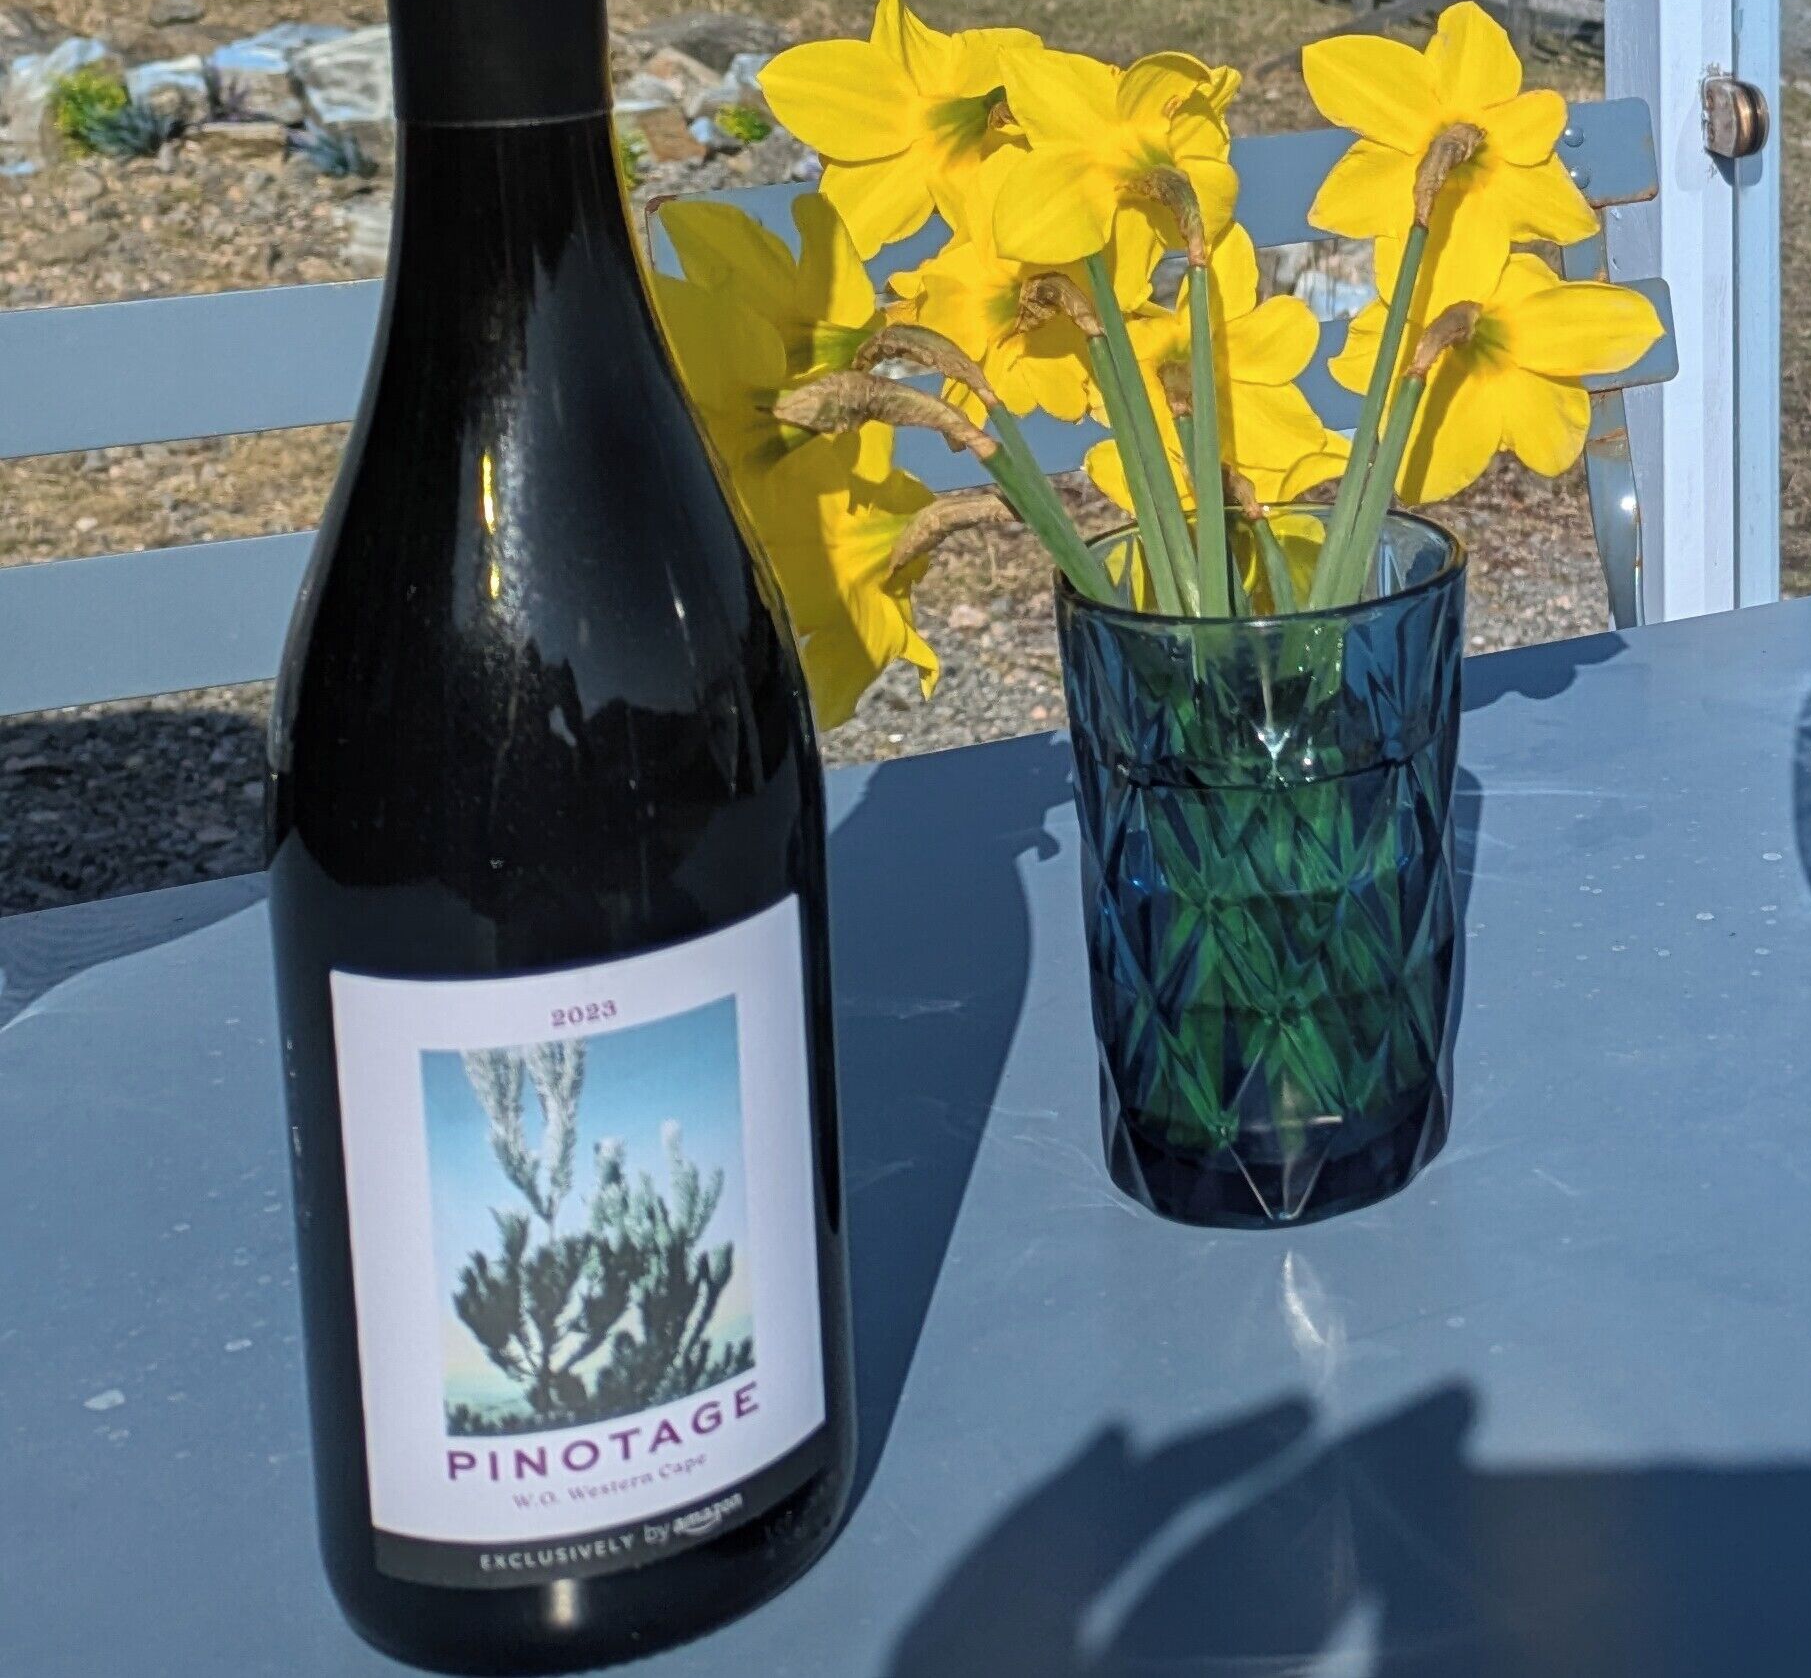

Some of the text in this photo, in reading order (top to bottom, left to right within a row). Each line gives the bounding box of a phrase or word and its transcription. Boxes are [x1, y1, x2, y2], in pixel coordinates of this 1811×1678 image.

[551, 999, 617, 1027] 2023
[446, 1381, 760, 1482] PINOTAGE
[567, 1473, 654, 1501] Western
[657, 1453, 707, 1480] Cape
[479, 1492, 743, 1571] EXCLUSIVELY by amazon
